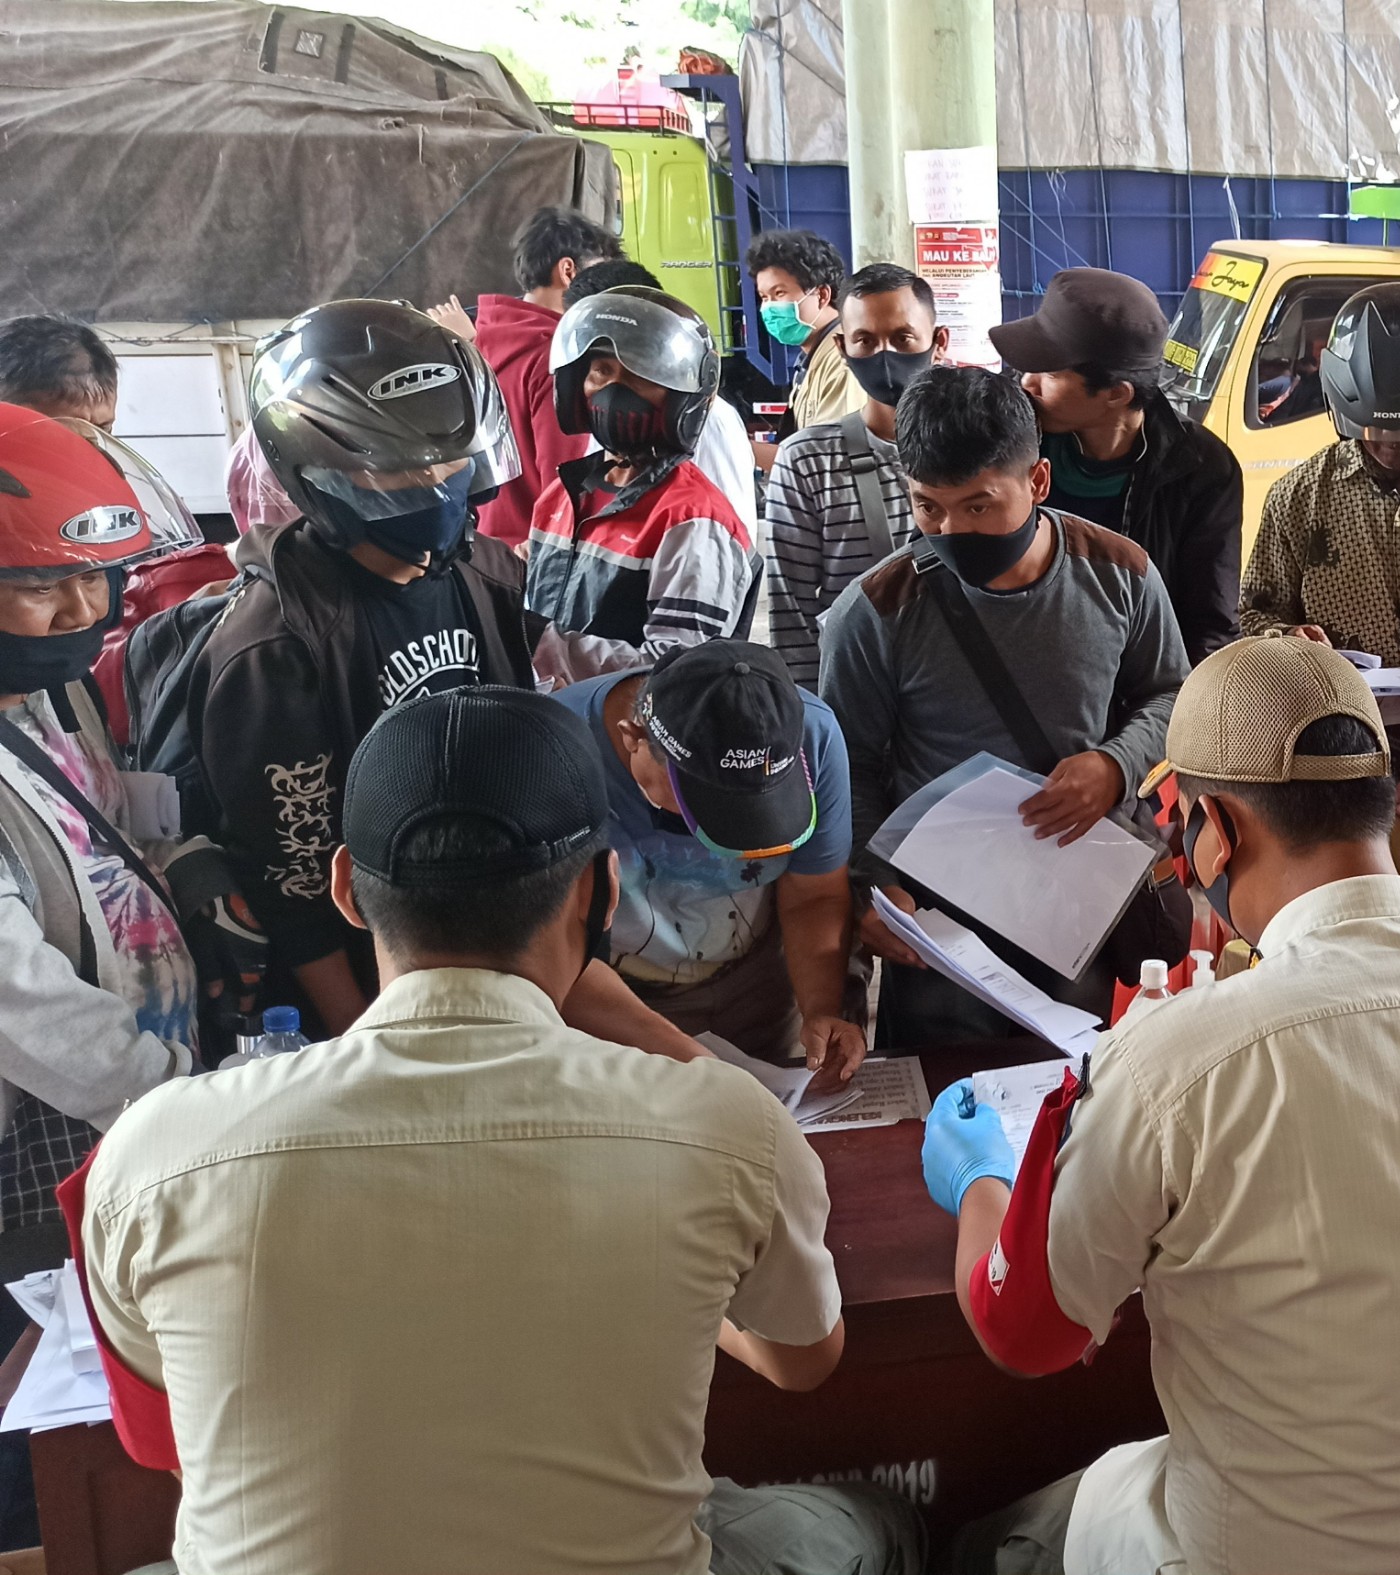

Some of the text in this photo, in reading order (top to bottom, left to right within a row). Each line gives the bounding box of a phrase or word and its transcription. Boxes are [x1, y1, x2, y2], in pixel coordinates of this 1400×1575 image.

[922, 250, 949, 262] MAU
[952, 250, 970, 262] KE
[595, 314, 638, 326] HONDA
[380, 367, 448, 395] INK
[668, 736, 692, 758] GAMES
[726, 748, 766, 759] ASIAN
[720, 756, 764, 769] GAMES
